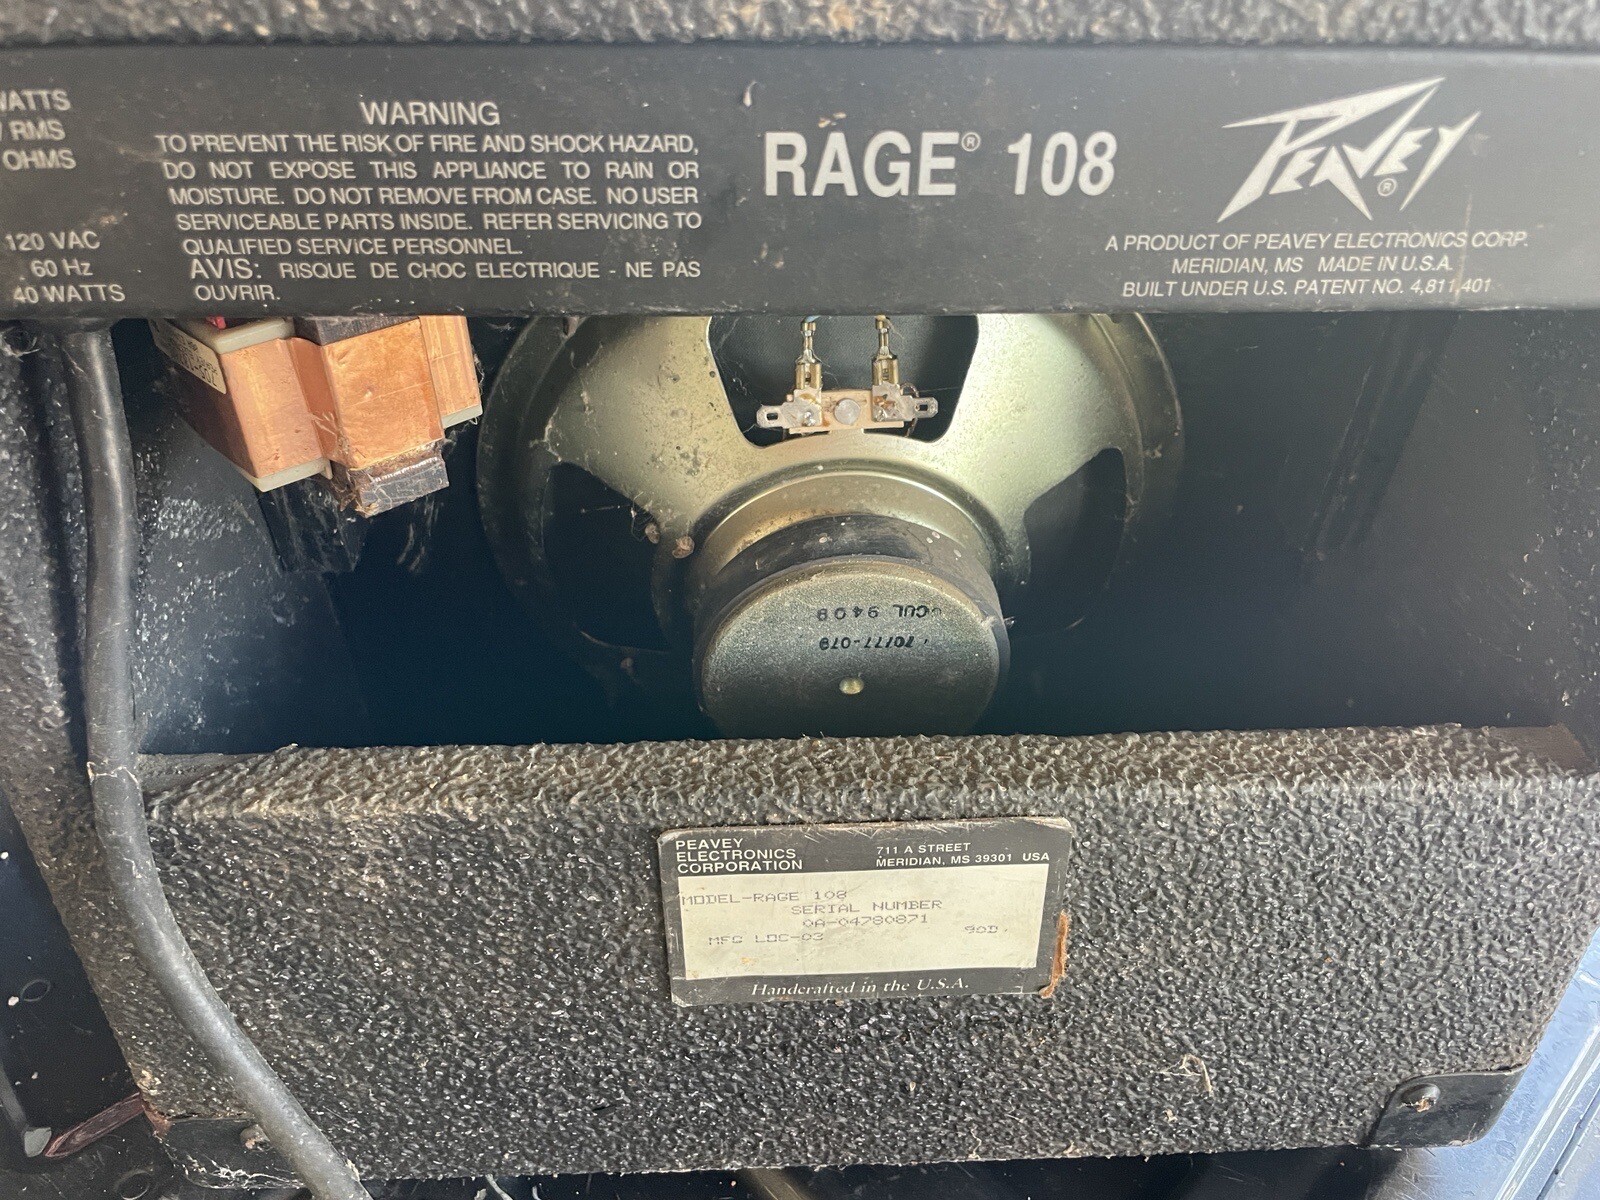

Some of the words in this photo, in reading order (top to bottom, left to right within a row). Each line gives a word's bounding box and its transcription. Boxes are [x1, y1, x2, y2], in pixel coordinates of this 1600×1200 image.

[360, 101, 500, 126] WARNING
[9, 118, 66, 140] RMS
[155, 135, 187, 153] TO
[190, 135, 288, 153] PREVENT
[294, 135, 339, 153] THE
[343, 135, 389, 153] RISK
[396, 135, 424, 153] OF
[430, 135, 477, 153] FIRE
[483, 135, 526, 153] AND
[531, 134, 605, 153] SHOCK
[1217, 77, 1481, 222] PEAVEY
[2, 148, 77, 171] OHMS
[1007, 131, 1117, 196] 108
[162, 161, 196, 180] DO
[210, 162, 252, 180] NOT
[270, 161, 356, 180] EXPOSE
[370, 162, 418, 179] THIS
[432, 162, 546, 179] APPLIANCE
[561, 162, 590, 179] TO
[606, 162, 654, 179] RAIN
[668, 162, 699, 179] OR
[168, 188, 285, 206] MOISTURE.
[294, 188, 326, 206] DO
[331, 188, 373, 205] NOT
[380, 188, 467, 205] REMOVE
[473, 188, 532, 205] FROM
[536, 188, 598, 205] CASE.
[607, 187, 638, 204] NO
[643, 187, 698, 204] USER
[177, 214, 320, 231] SERVICEABLE
[326, 214, 395, 231] PARTS
[401, 213, 473, 230] INSIDE.
[484, 213, 552, 230] REFER
[558, 212, 669, 230] SERVICING
[674, 212, 702, 230] TO
[5, 234, 44, 251] 120
[51, 231, 100, 250] VAC
[182, 239, 292, 256] QUALIFIED
[298, 239, 388, 255] SERVICE
[393, 238, 523, 255] PERSONNEL.
[1105, 236, 1118, 251] A
[1124, 235, 1220, 251] PRODUCT
[1223, 235, 1250, 250] OF
[1254, 234, 1331, 250] PEAVEY
[1334, 232, 1467, 249] ELECTRONICS
[1471, 231, 1528, 248] CORP.
[31, 260, 57, 277] 60
[62, 258, 94, 276] Hz
[191, 258, 262, 280] AVIS:
[280, 263, 357, 280] RISQUE
[371, 263, 399, 279] DE
[408, 263, 466, 279] CHOC
[477, 262, 600, 279] ELECTRIQUE
[626, 262, 654, 278] NE
[664, 262, 701, 278] PAS
[1172, 258, 1269, 275] MERIDIAN,
[1274, 258, 1303, 272] MS
[1318, 257, 1372, 272] MADE
[1378, 257, 1397, 271] IN
[13, 286, 39, 303] 40
[43, 284, 125, 302] WATTS
[195, 284, 281, 302] OUVRIR.
[1123, 282, 1177, 297] BUILT
[1181, 281, 1248, 297] UNDER
[1253, 281, 1288, 296] U.S.
[1295, 280, 1366, 296] PATENT
[1371, 280, 1405, 294] NO.
[1410, 279, 1491, 295] 4,811,401
[675, 838, 743, 850] PEAVEY
[876, 846, 898, 854] 711
[904, 845, 913, 854] A
[918, 843, 971, 853] STREET
[676, 849, 796, 862] ELECTRONICS
[876, 857, 945, 867] MERIDIAN,
[950, 855, 970, 864] MS
[975, 854, 1012, 863] 39301
[1022, 852, 1050, 861] USA
[677, 860, 803, 874] CORPORATION
[682, 892, 799, 905] MODEL-RAGE
[814, 891, 847, 900] 108
[791, 904, 860, 914] SERIAL
[872, 900, 943, 911] NUMBER
[708, 936, 743, 945] MFG
[751, 982, 854, 995] Handcrafted
[861, 981, 876, 992] in
[884, 979, 910, 991] the
[917, 978, 969, 990] U.S.A.
